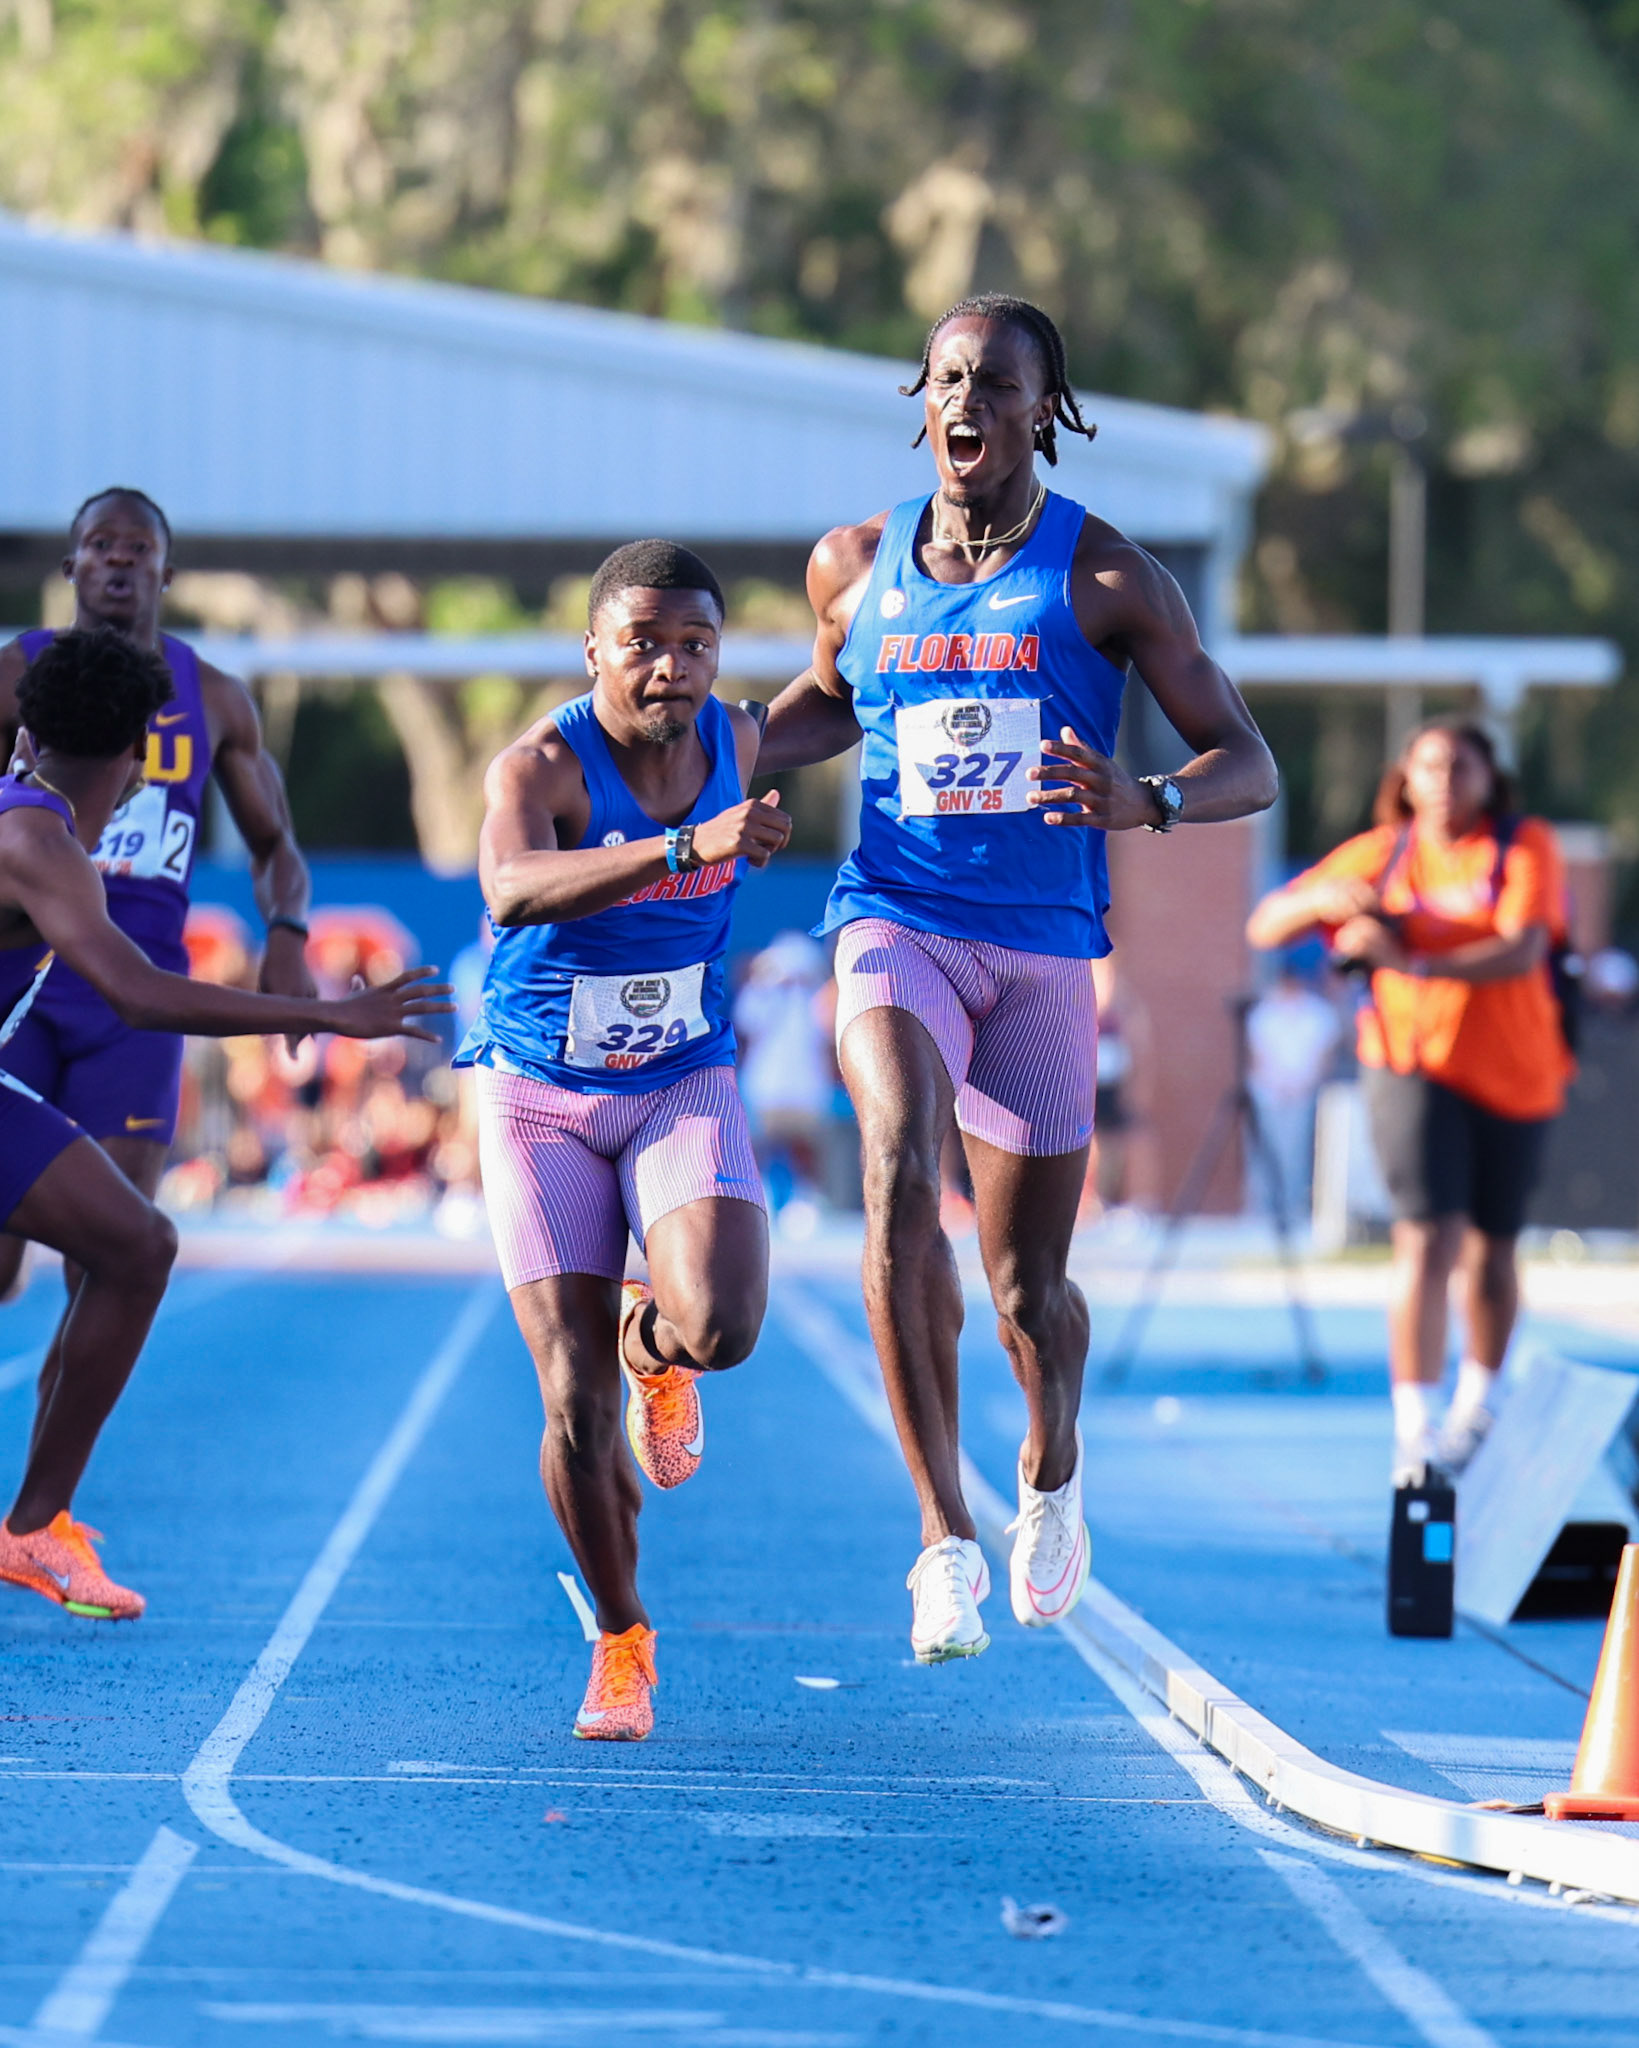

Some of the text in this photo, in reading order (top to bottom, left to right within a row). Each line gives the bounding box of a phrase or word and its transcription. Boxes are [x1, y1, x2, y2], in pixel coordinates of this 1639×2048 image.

[875, 633, 1039, 673] FLORIDA
[144, 733, 193, 782] U
[927, 752, 1023, 788] 327
[936, 790, 974, 812] GNV
[164, 822, 189, 874] 2
[596, 1018, 688, 1053] 329
[605, 1053, 644, 1070] GNV
